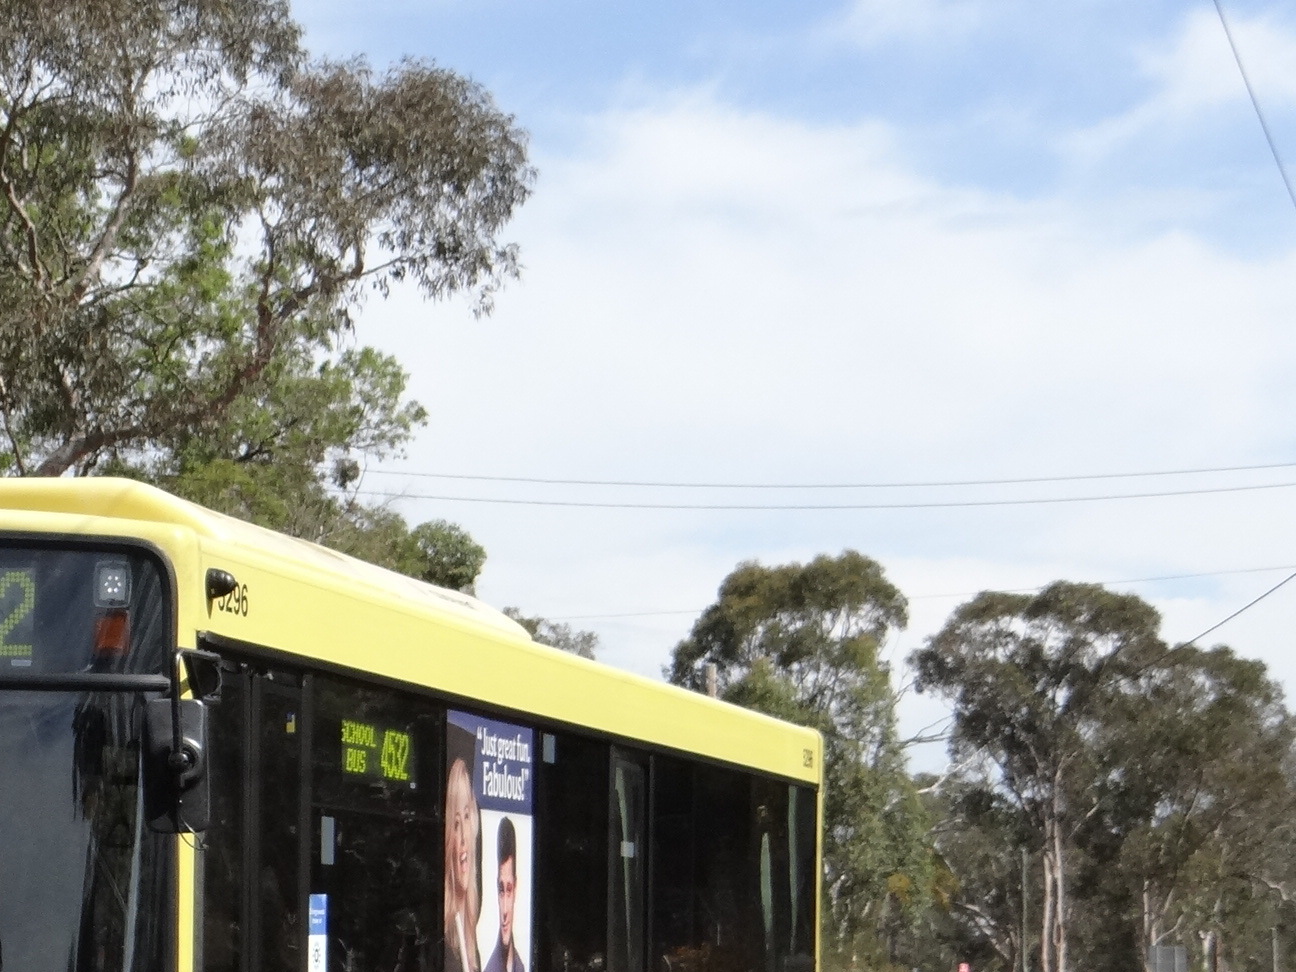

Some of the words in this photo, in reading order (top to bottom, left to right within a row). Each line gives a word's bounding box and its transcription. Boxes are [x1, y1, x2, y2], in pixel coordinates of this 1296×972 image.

[346, 748, 366, 773] BUS
[381, 730, 409, 780] 4532
[497, 738, 516, 765] great
[516, 733, 531, 763] fun.
